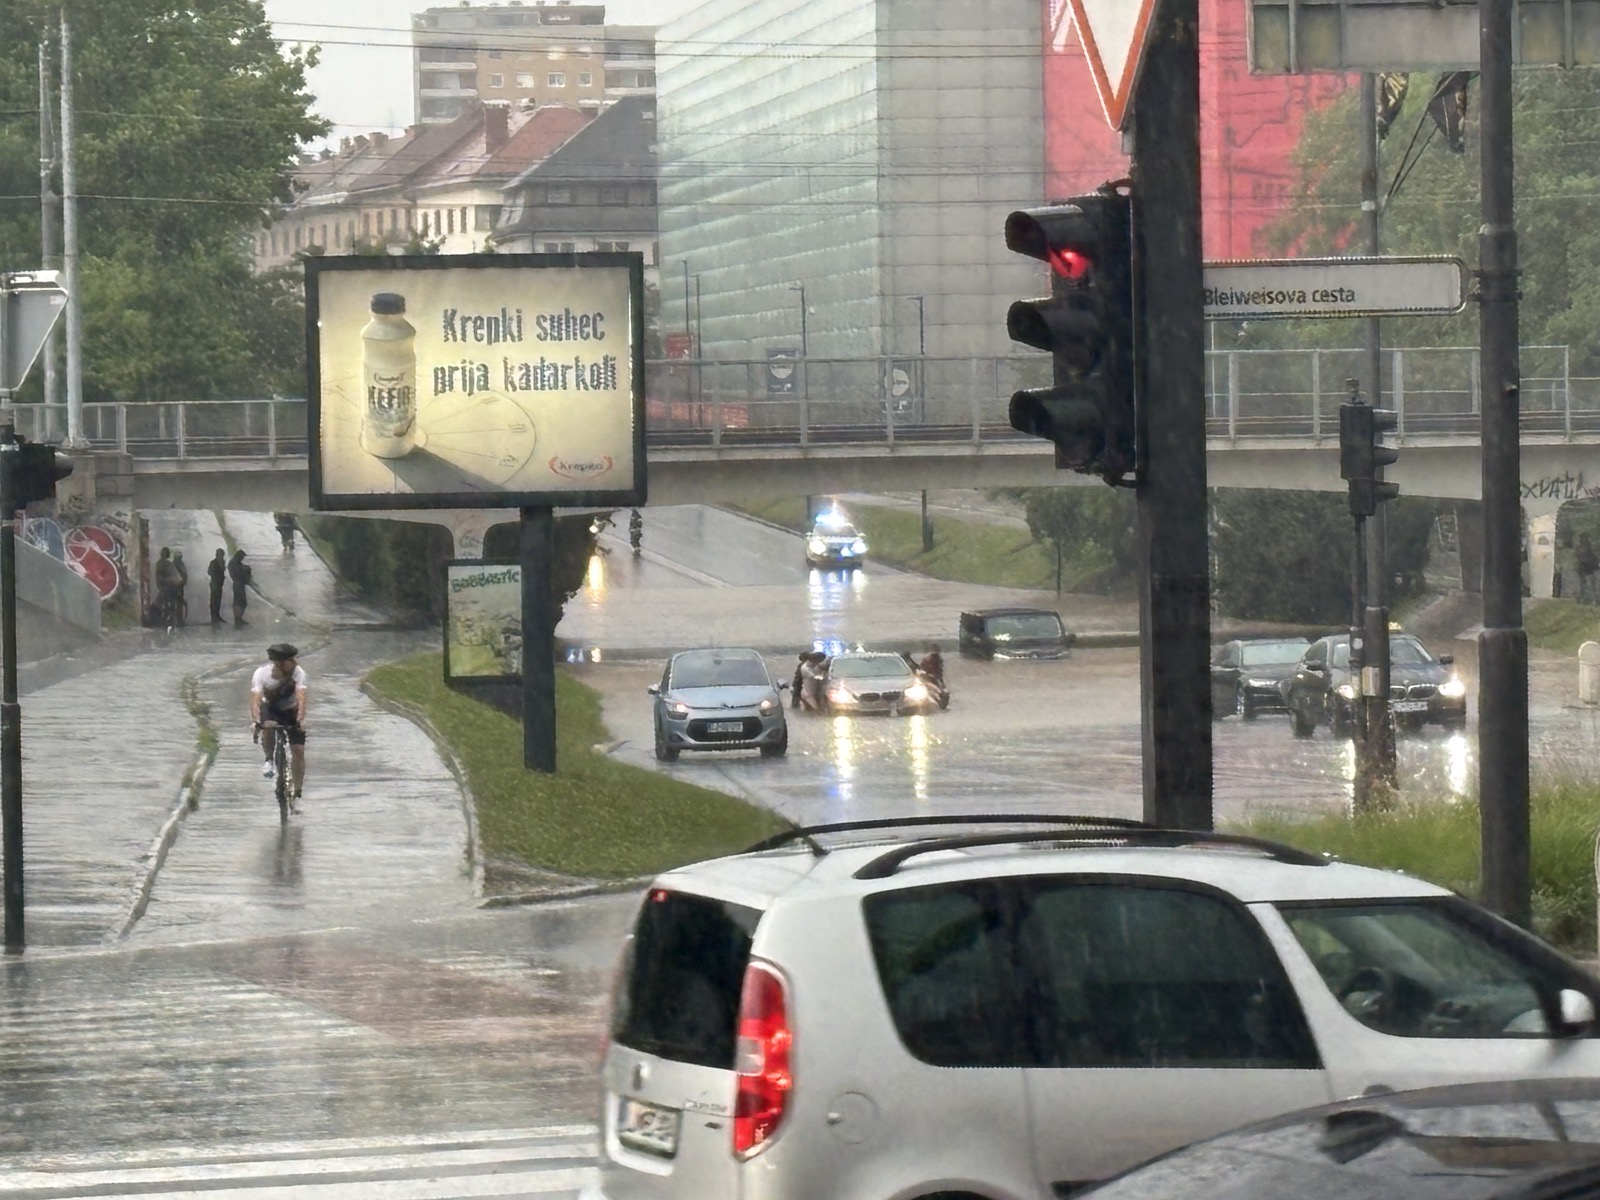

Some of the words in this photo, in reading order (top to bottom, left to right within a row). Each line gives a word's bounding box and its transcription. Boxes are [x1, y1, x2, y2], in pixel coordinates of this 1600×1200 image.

[1203, 287, 1307, 306] Bleiweisova
[1311, 287, 1356, 304] cesta
[443, 307, 523, 345] Krepki
[535, 307, 606, 342] suhec
[433, 358, 490, 397] prija
[502, 354, 617, 393] kadarkoli
